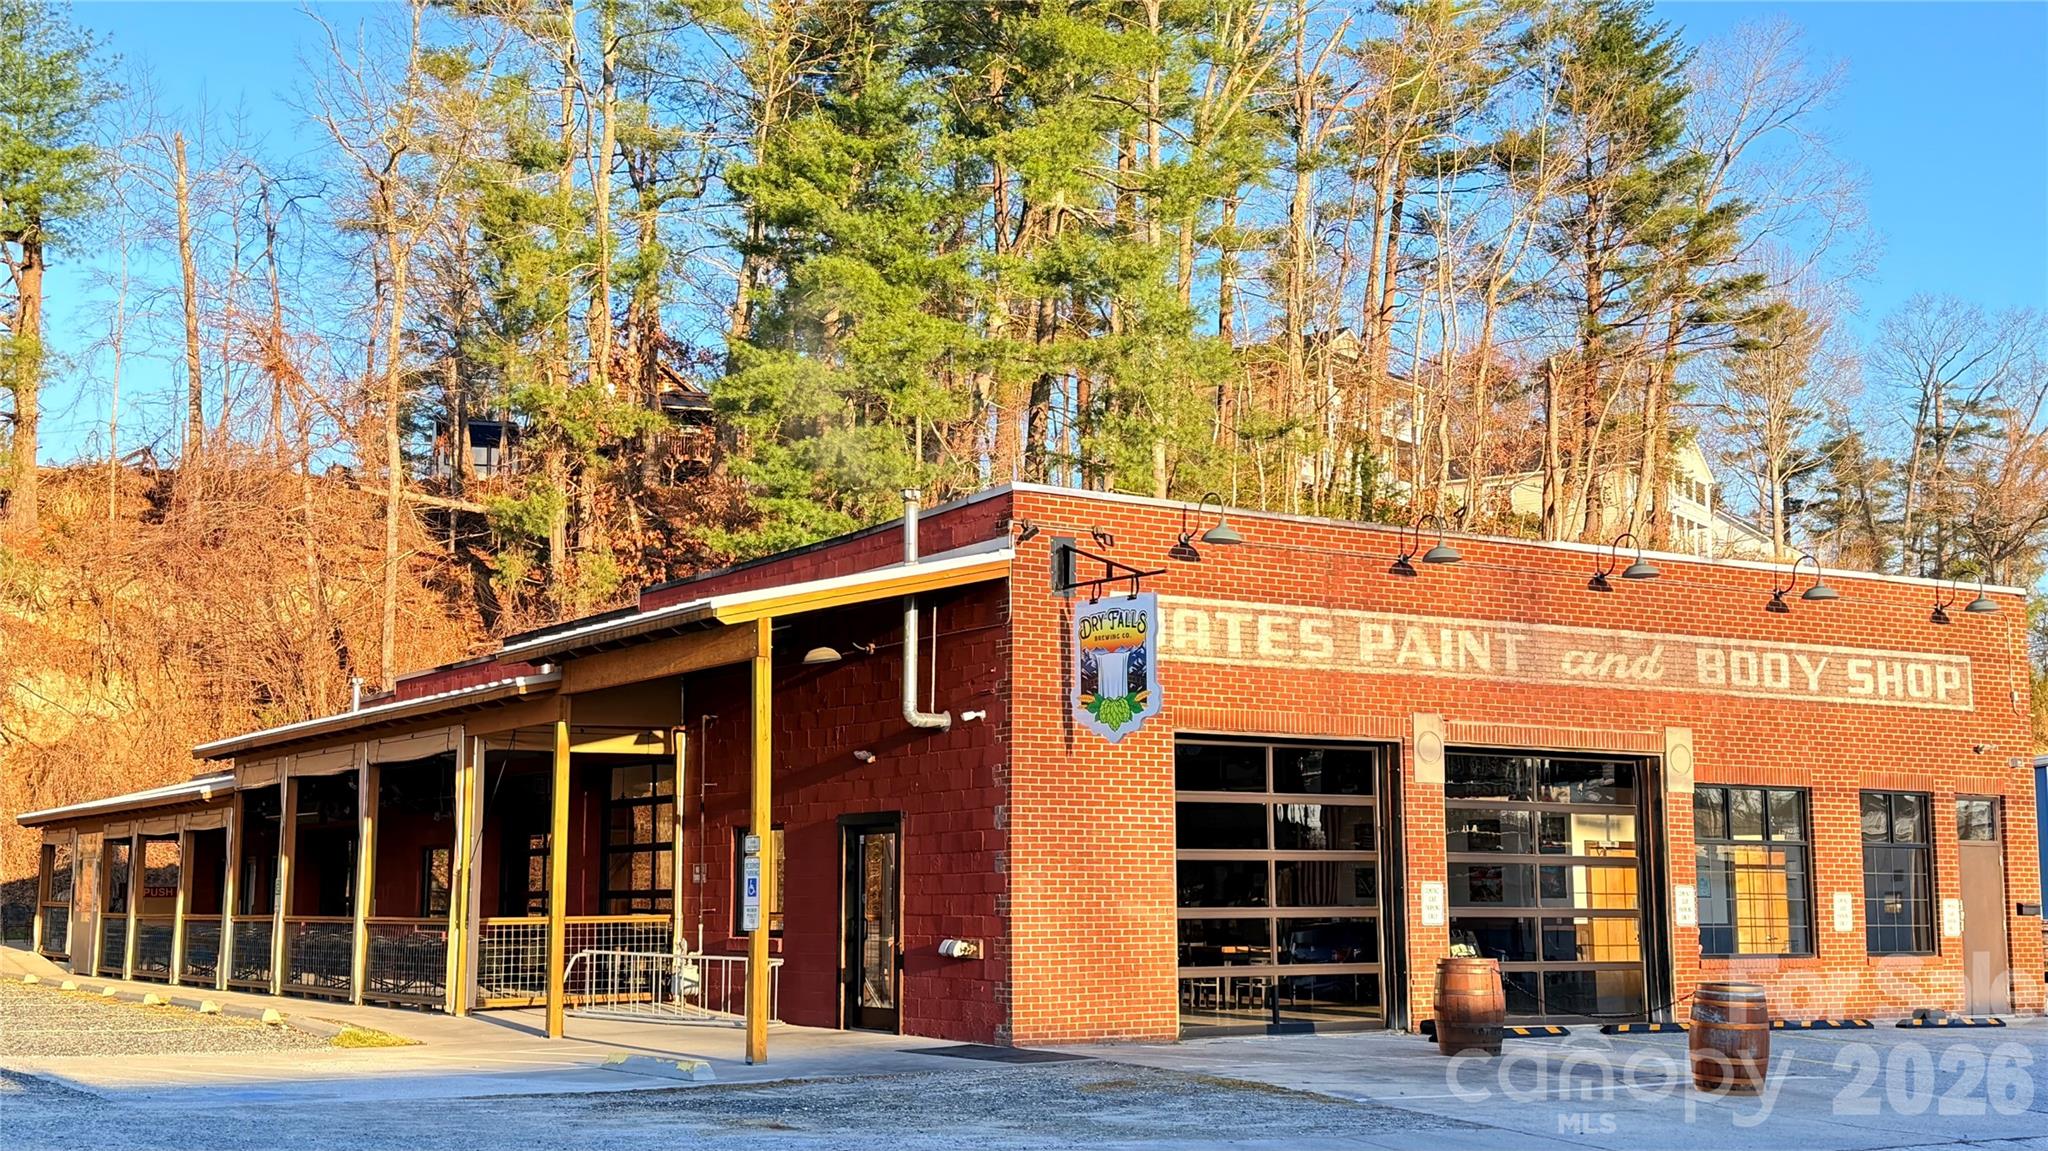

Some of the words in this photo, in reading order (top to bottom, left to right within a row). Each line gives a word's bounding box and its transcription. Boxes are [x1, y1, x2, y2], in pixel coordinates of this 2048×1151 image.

[1079, 612, 1105, 640] DRY
[1107, 609, 1147, 634] FALLS
[1094, 633, 1120, 641] BREWING
[1157, 607, 1335, 658] ATES
[1359, 622, 1527, 672] PAINT
[1561, 644, 1666, 681] and
[1696, 647, 1829, 692] BODY
[1847, 658, 1962, 700] SHOP
[144, 887, 173, 896] PUSH
